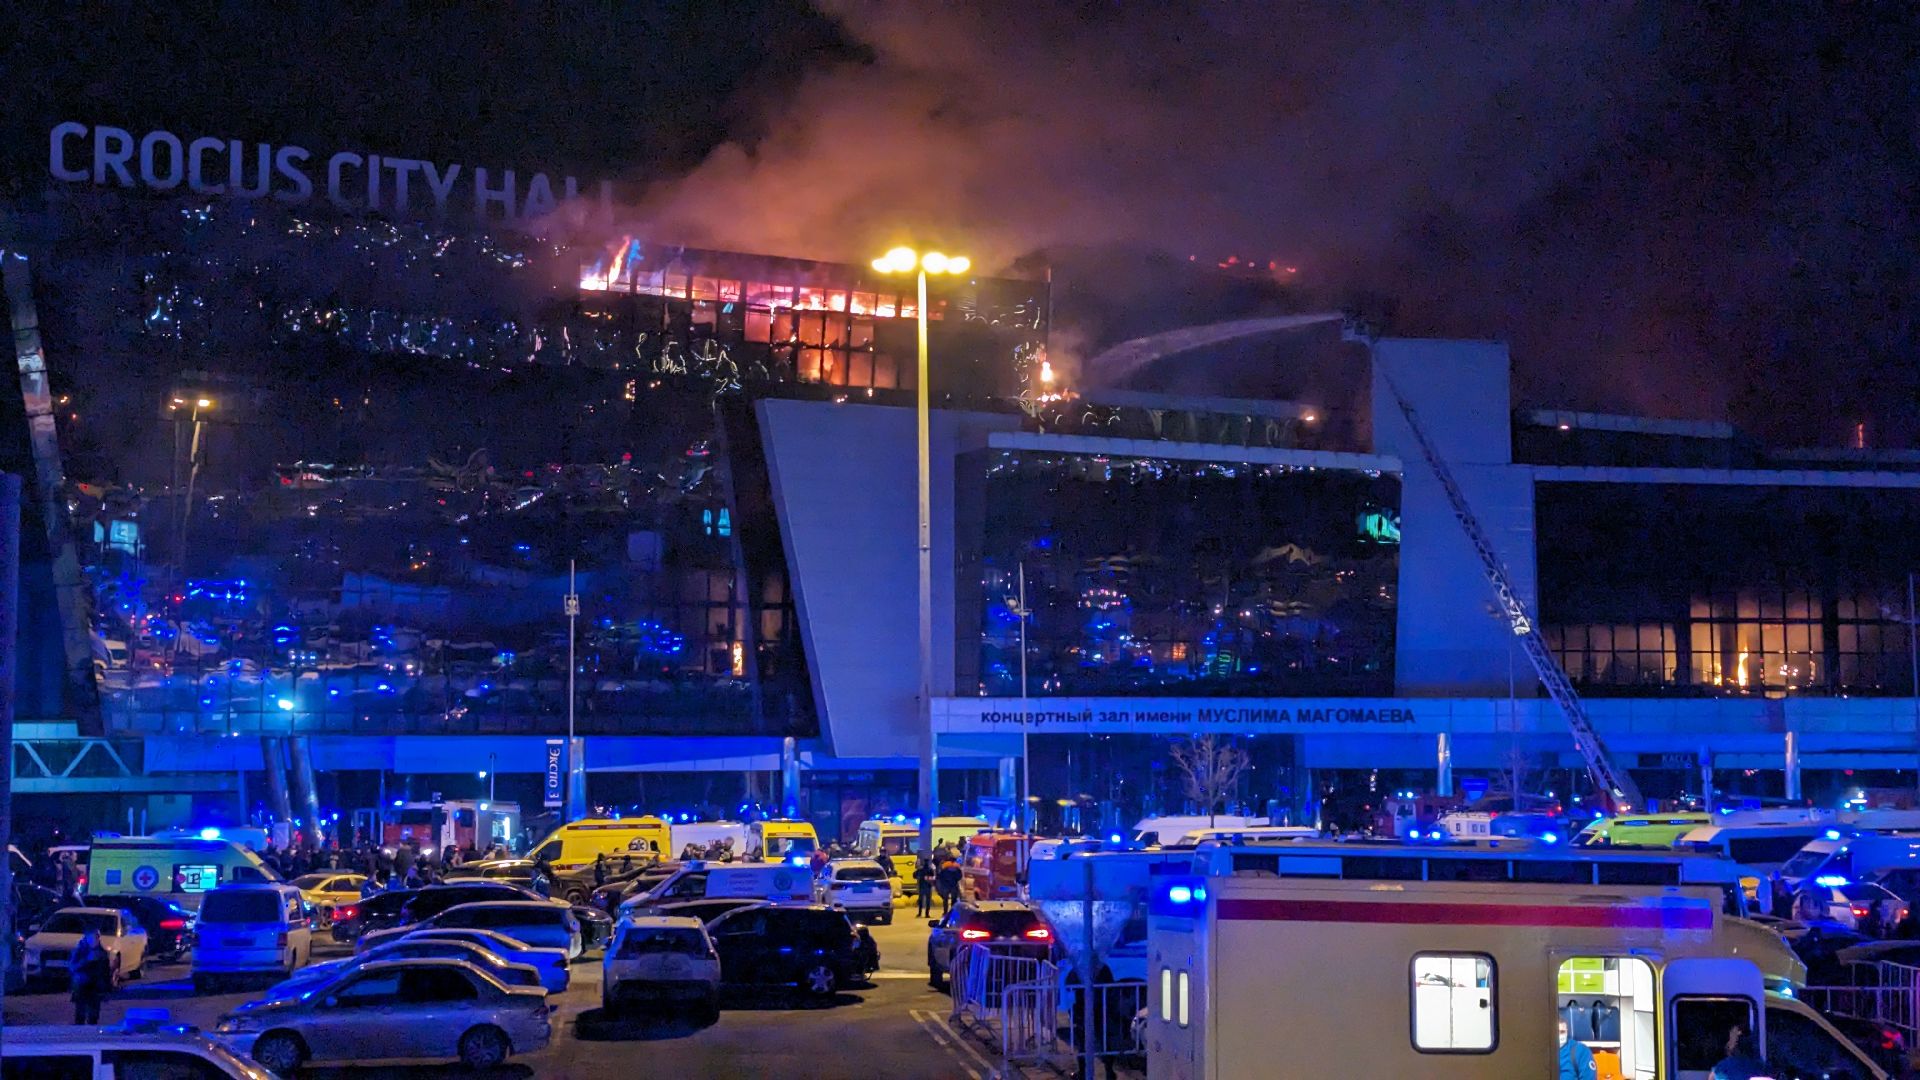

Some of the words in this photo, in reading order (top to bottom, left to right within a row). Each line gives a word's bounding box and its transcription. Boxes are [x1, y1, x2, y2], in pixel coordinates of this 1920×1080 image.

[50, 121, 313, 201] CROCUS
[327, 151, 461, 215] CITY
[981, 708, 1093, 727] концертный
[1099, 711, 1129, 723] зал
[1135, 711, 1191, 723] имени
[1198, 708, 1292, 723] МУСЛИМА
[1296, 708, 1415, 723] МАГОМАЕВА
[549, 747, 560, 788] ЭКСПО
